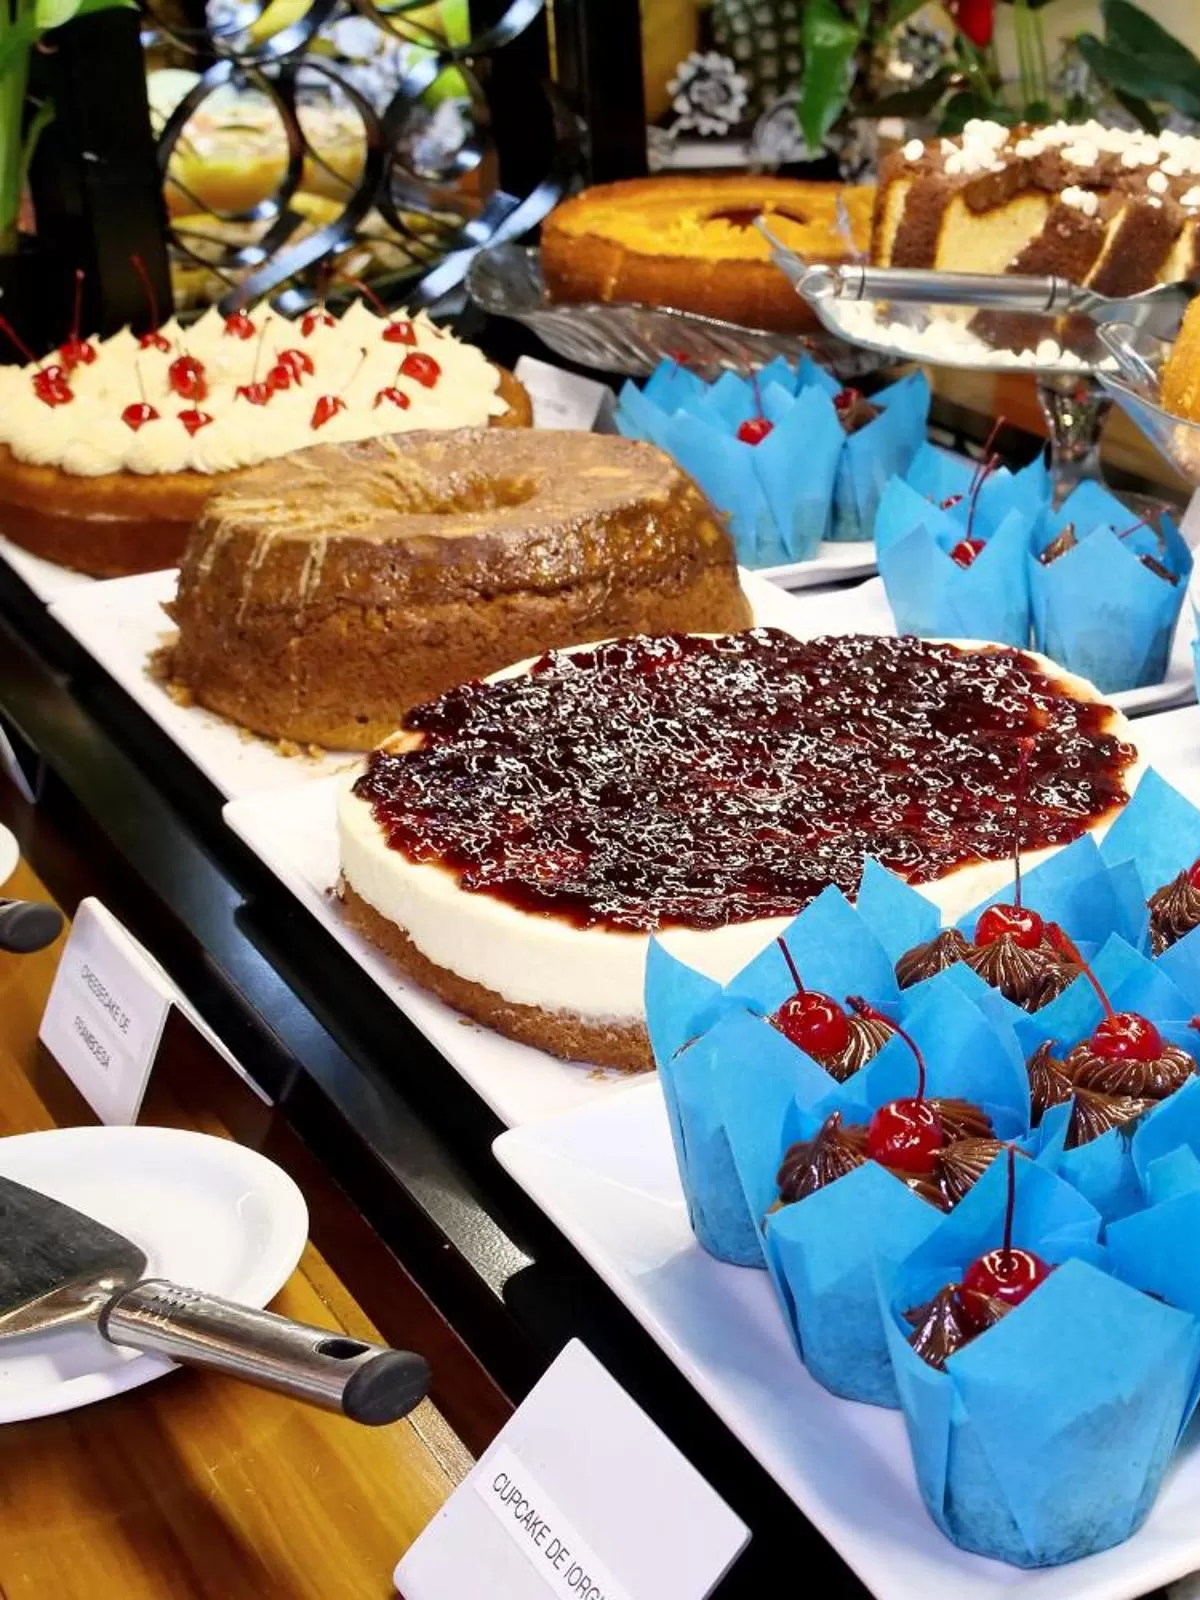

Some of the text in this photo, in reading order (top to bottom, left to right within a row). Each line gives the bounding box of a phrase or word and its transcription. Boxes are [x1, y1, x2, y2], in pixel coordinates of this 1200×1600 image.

[119, 1014, 131, 1034] DE
[492, 1473, 606, 1600] CUPCAKE DE IORG
